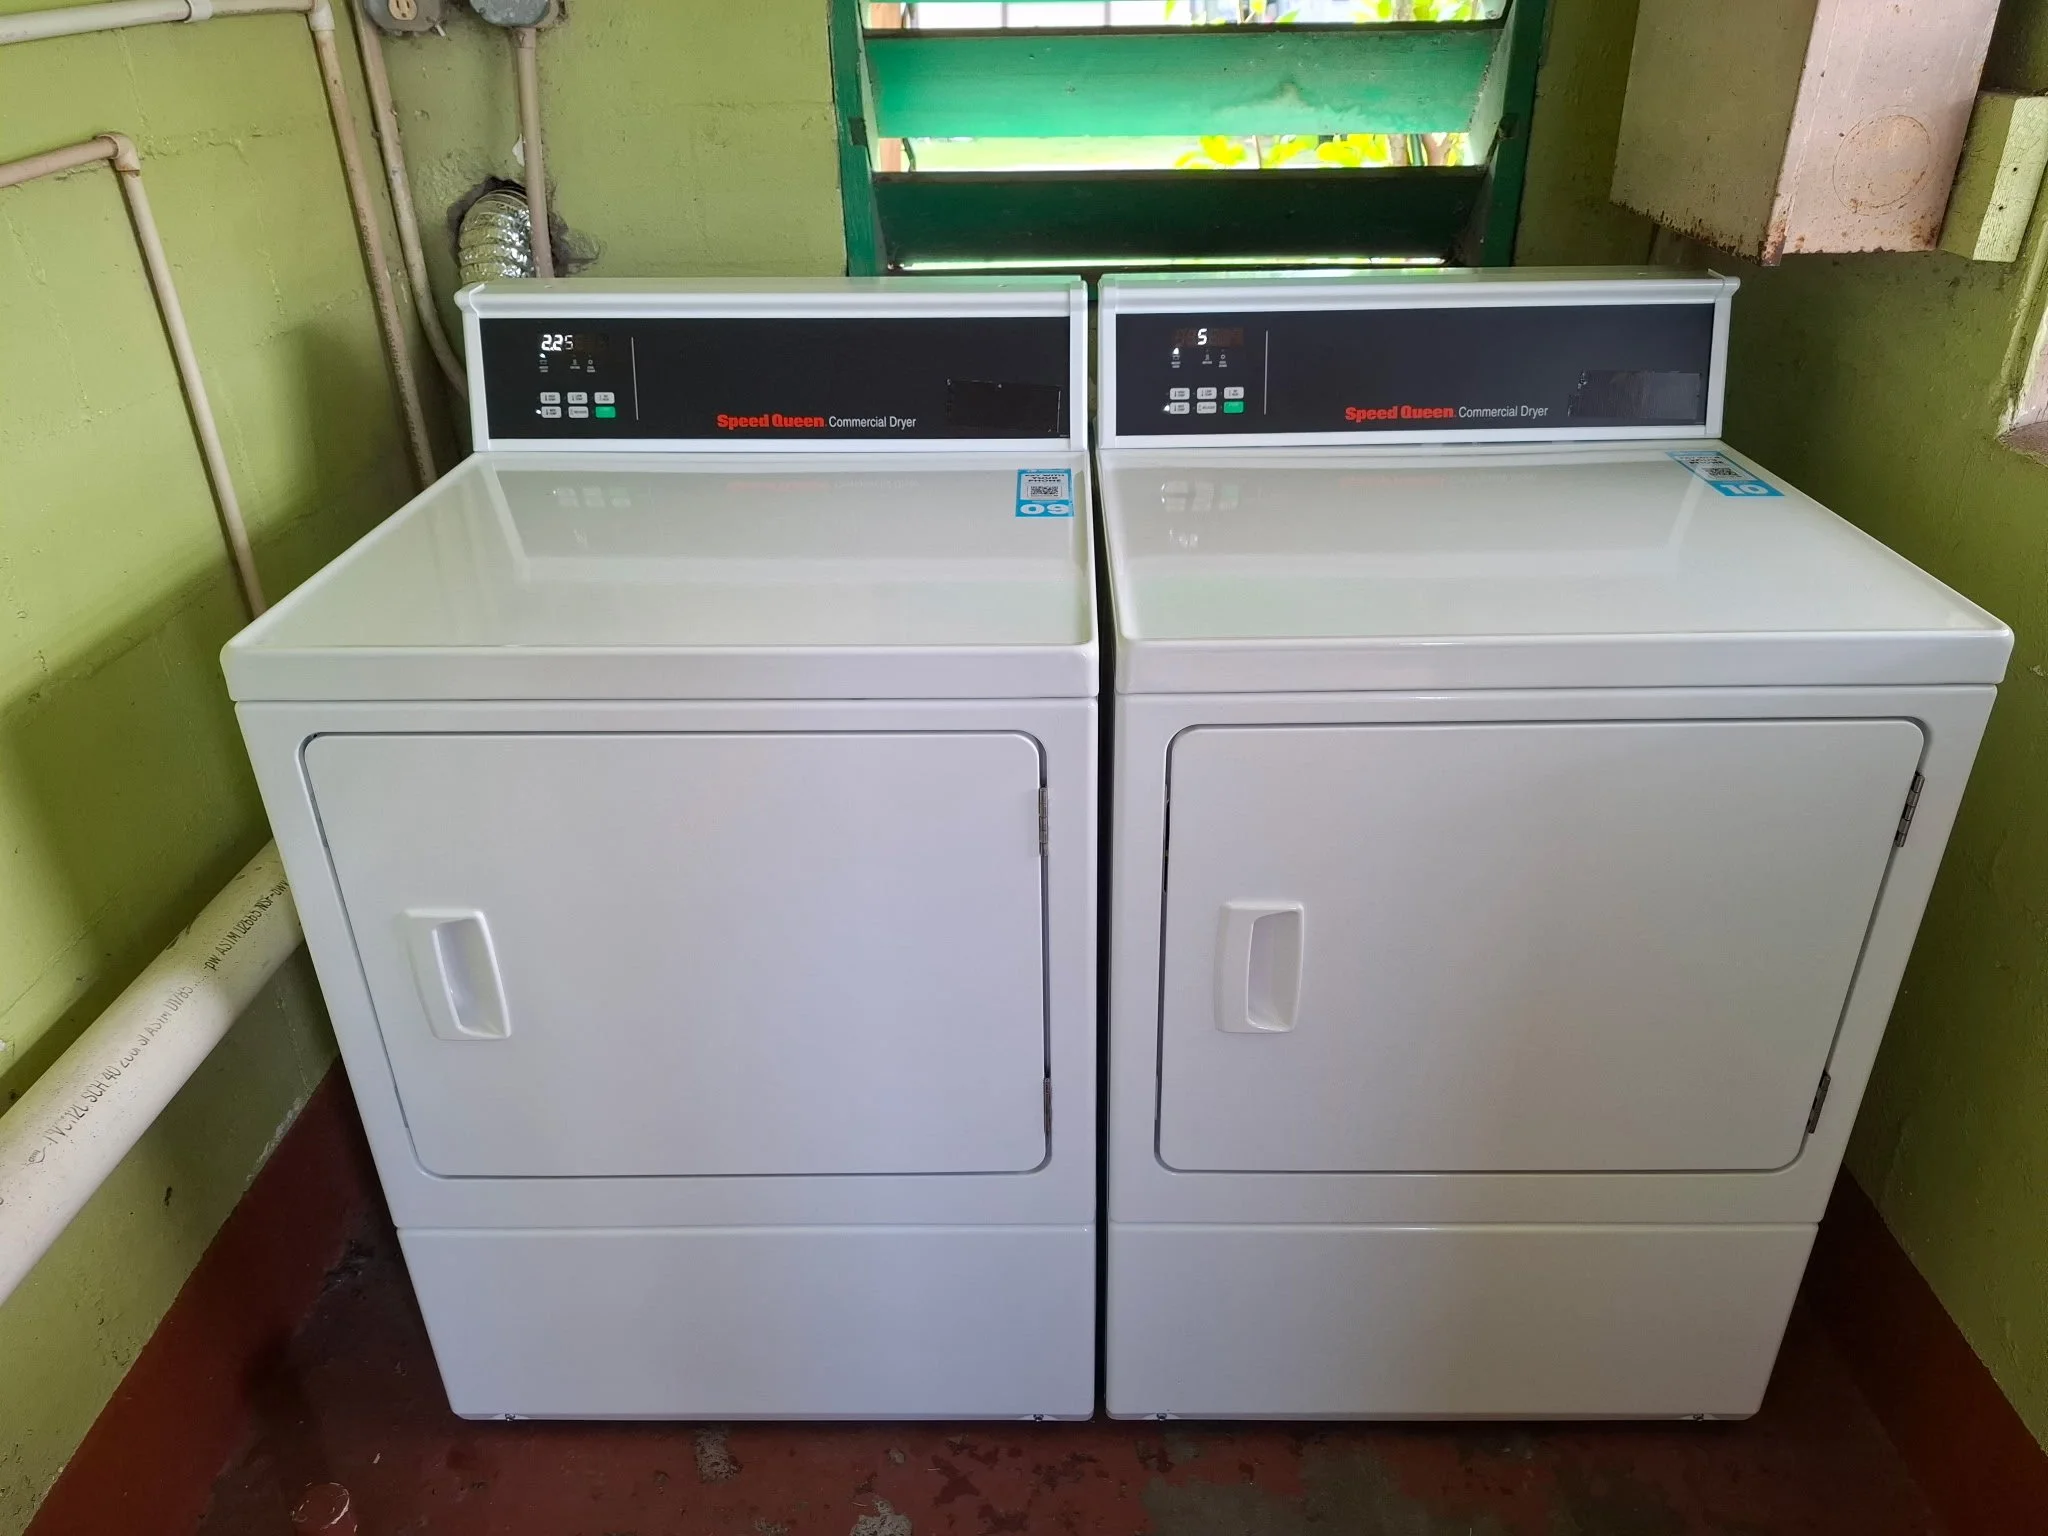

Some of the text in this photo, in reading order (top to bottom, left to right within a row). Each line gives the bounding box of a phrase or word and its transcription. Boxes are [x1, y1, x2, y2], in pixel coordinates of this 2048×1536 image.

[1197, 328, 1208, 346] 5
[717, 413, 917, 430] Speed Queen Commercial Dryer
[1345, 405, 1549, 422] Speed Queen Commercial Dryer
[1720, 484, 1768, 495] 10
[1020, 503, 1070, 515] 09
[81, 1080, 110, 1103] SCH
[102, 1065, 122, 1081] 40
[215, 931, 241, 956] ASTM
